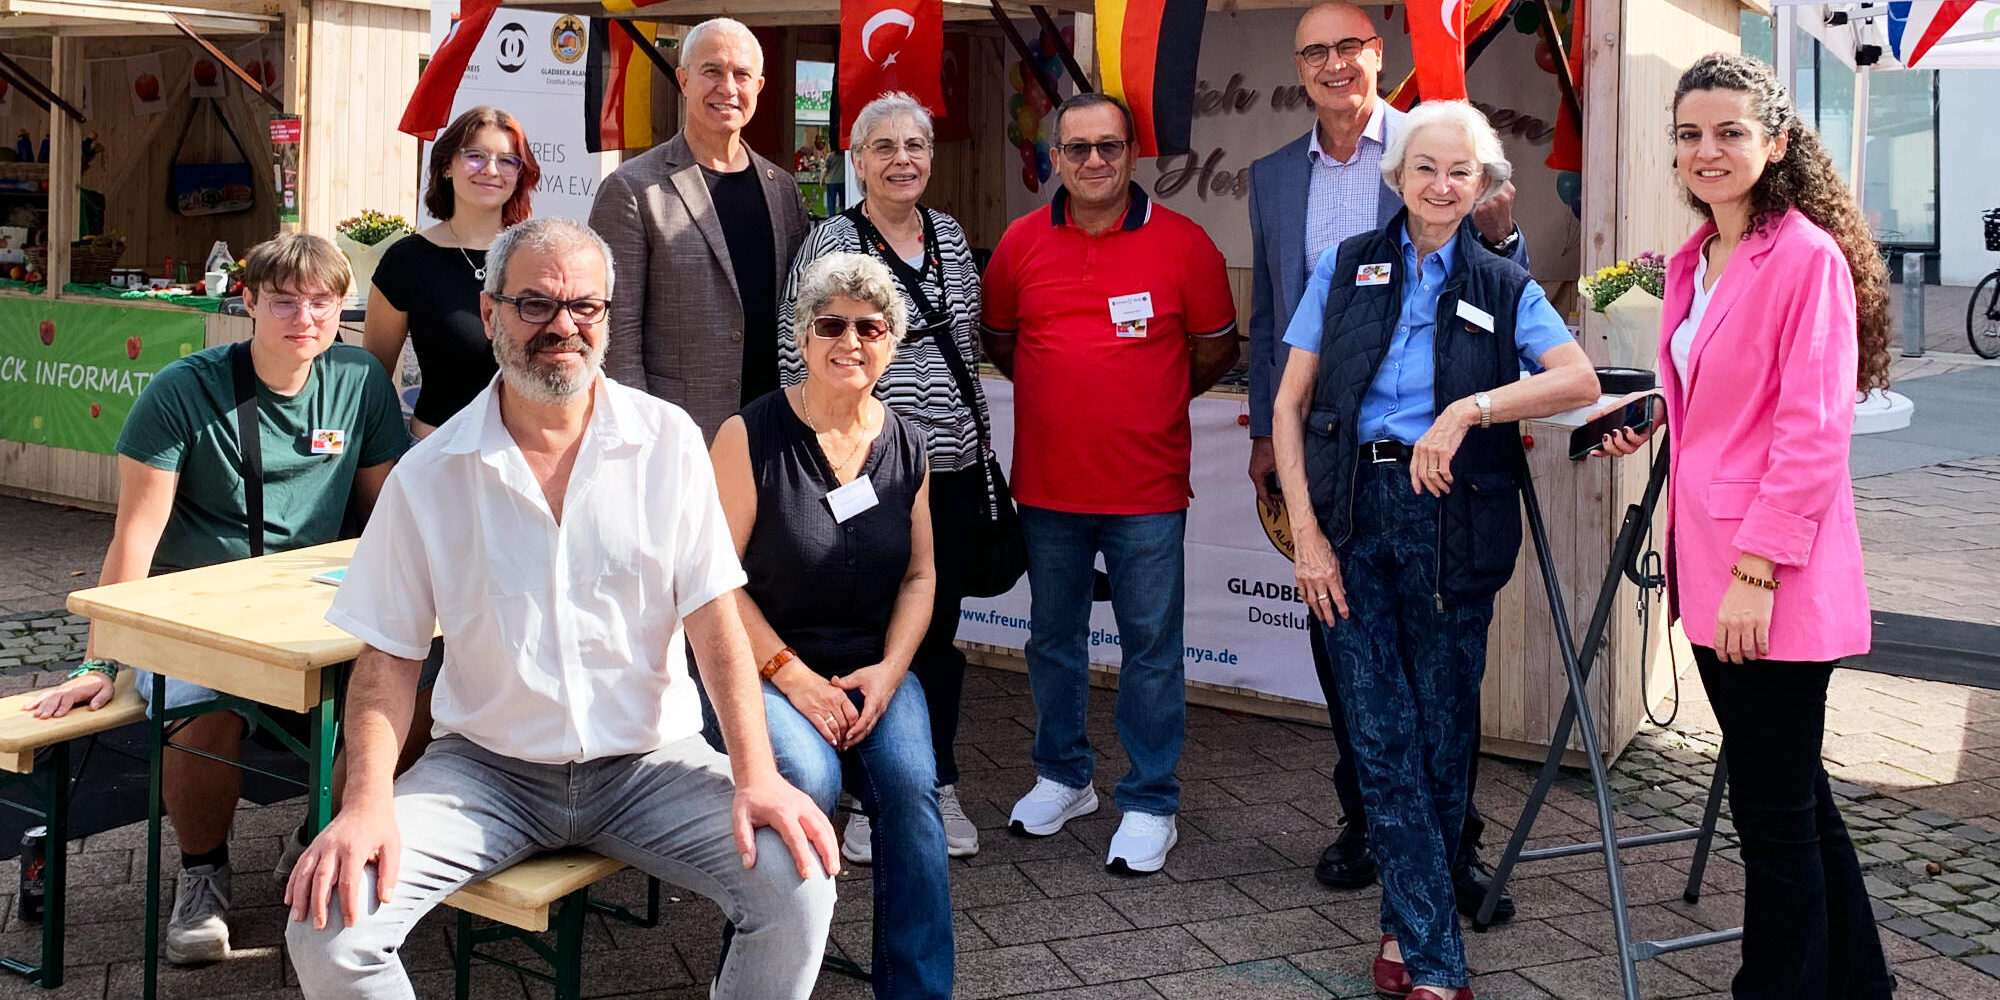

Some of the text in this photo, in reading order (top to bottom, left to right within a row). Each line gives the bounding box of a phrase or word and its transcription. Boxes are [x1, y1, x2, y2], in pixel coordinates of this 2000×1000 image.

[529, 142, 566, 163] REIS
[569, 175, 595, 197] E.V.
[0, 356, 155, 397] CK INFORMAT
